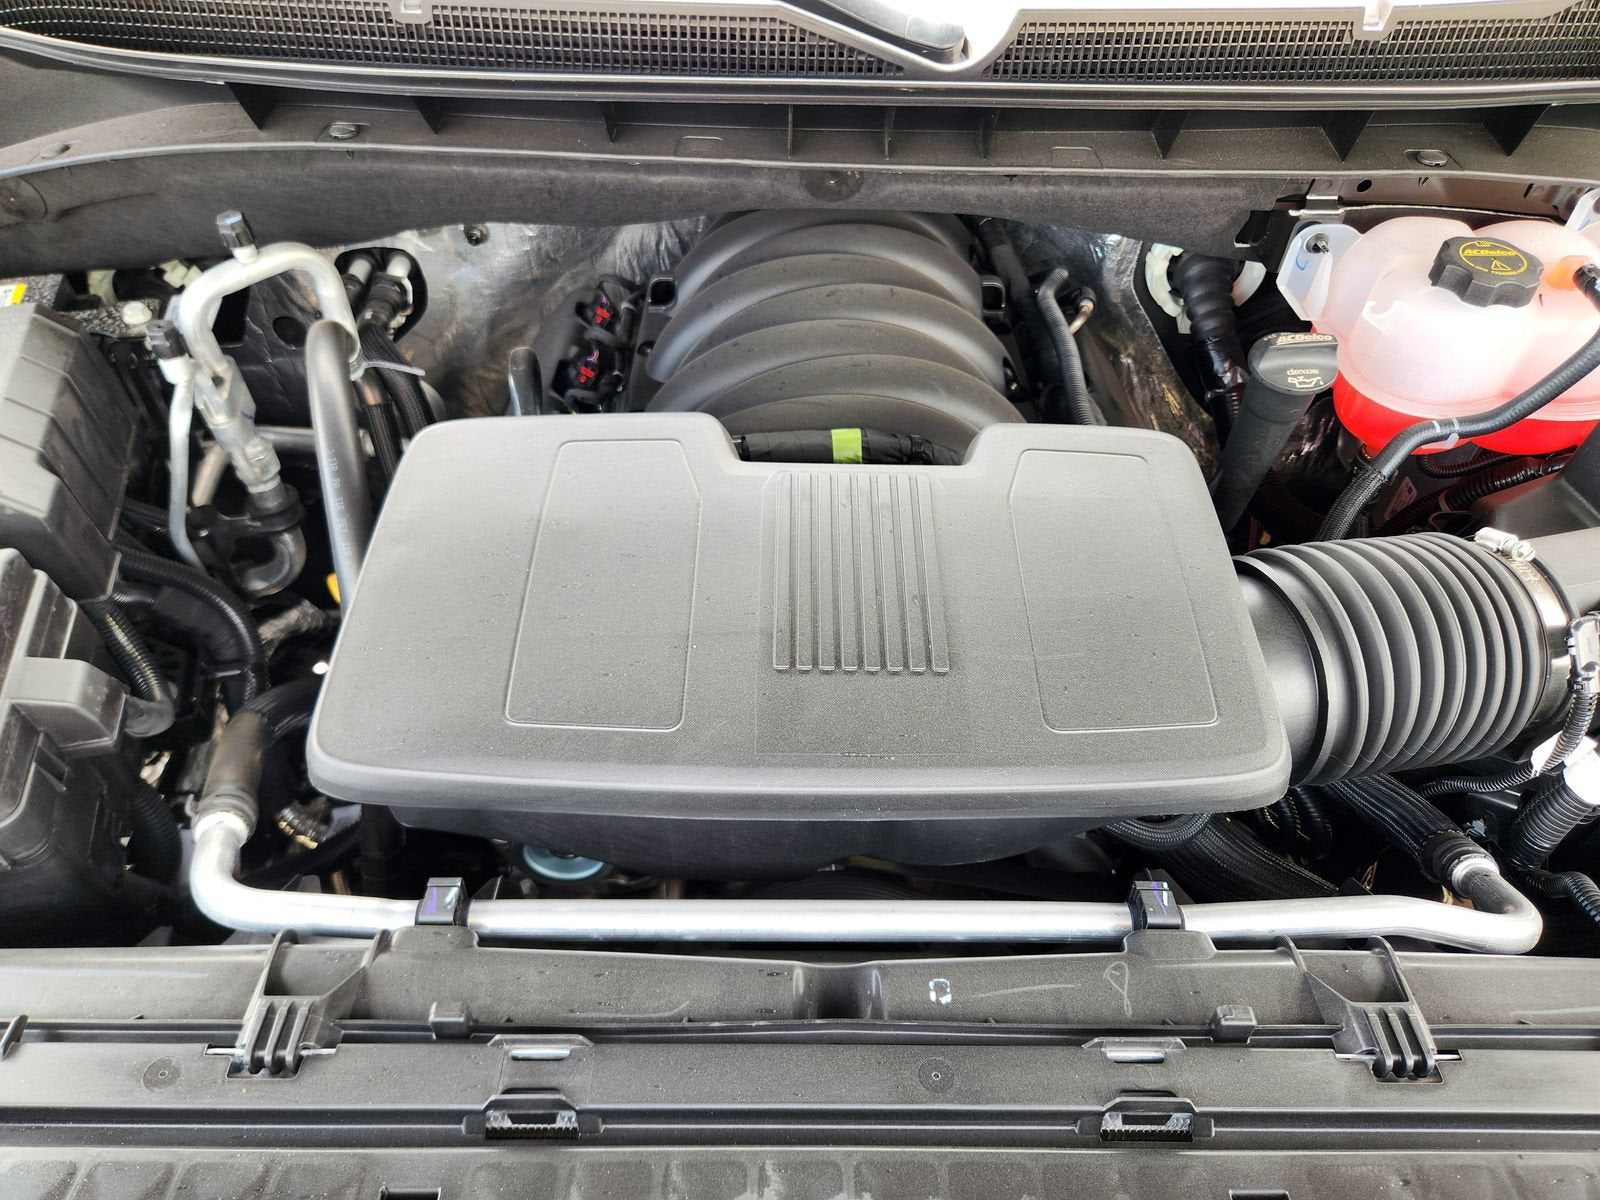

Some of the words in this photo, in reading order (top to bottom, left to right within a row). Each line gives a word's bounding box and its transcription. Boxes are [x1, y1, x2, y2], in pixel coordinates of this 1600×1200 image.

[1462, 248, 1518, 256] ACDelco
[1277, 333, 1333, 343] ACDelco
[1286, 368, 1319, 376] dexos
